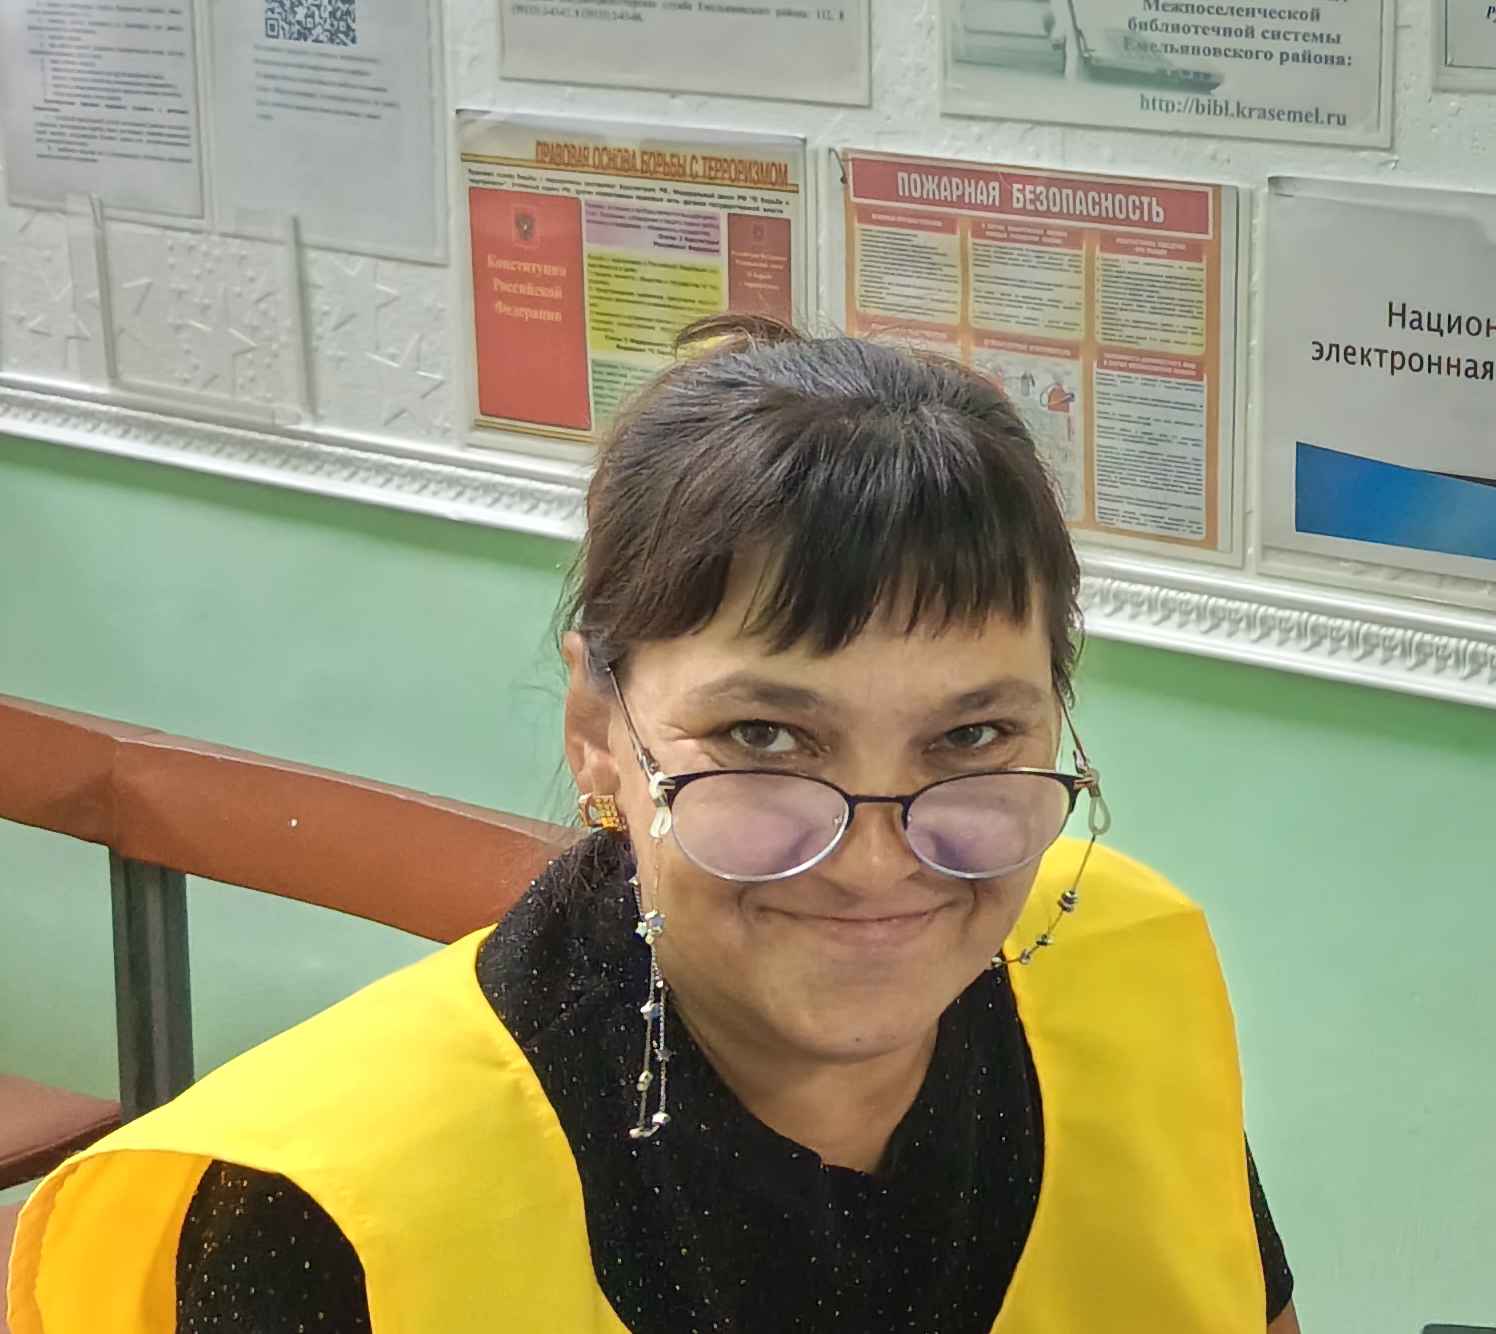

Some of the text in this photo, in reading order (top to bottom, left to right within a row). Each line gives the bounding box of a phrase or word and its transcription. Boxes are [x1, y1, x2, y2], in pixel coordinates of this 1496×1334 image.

[1128, 17, 1342, 46] библиотечной системы
[1123, 36, 1353, 67] Емельяновского района:
[897, 171, 1165, 224] ПОЖАРНАЯ БЕЗОПАСНОСТЬ
[487, 254, 567, 279] Конституция
[492, 277, 563, 299] Российской
[494, 300, 562, 322] Федерации
[1311, 338, 1495, 381] электронная
